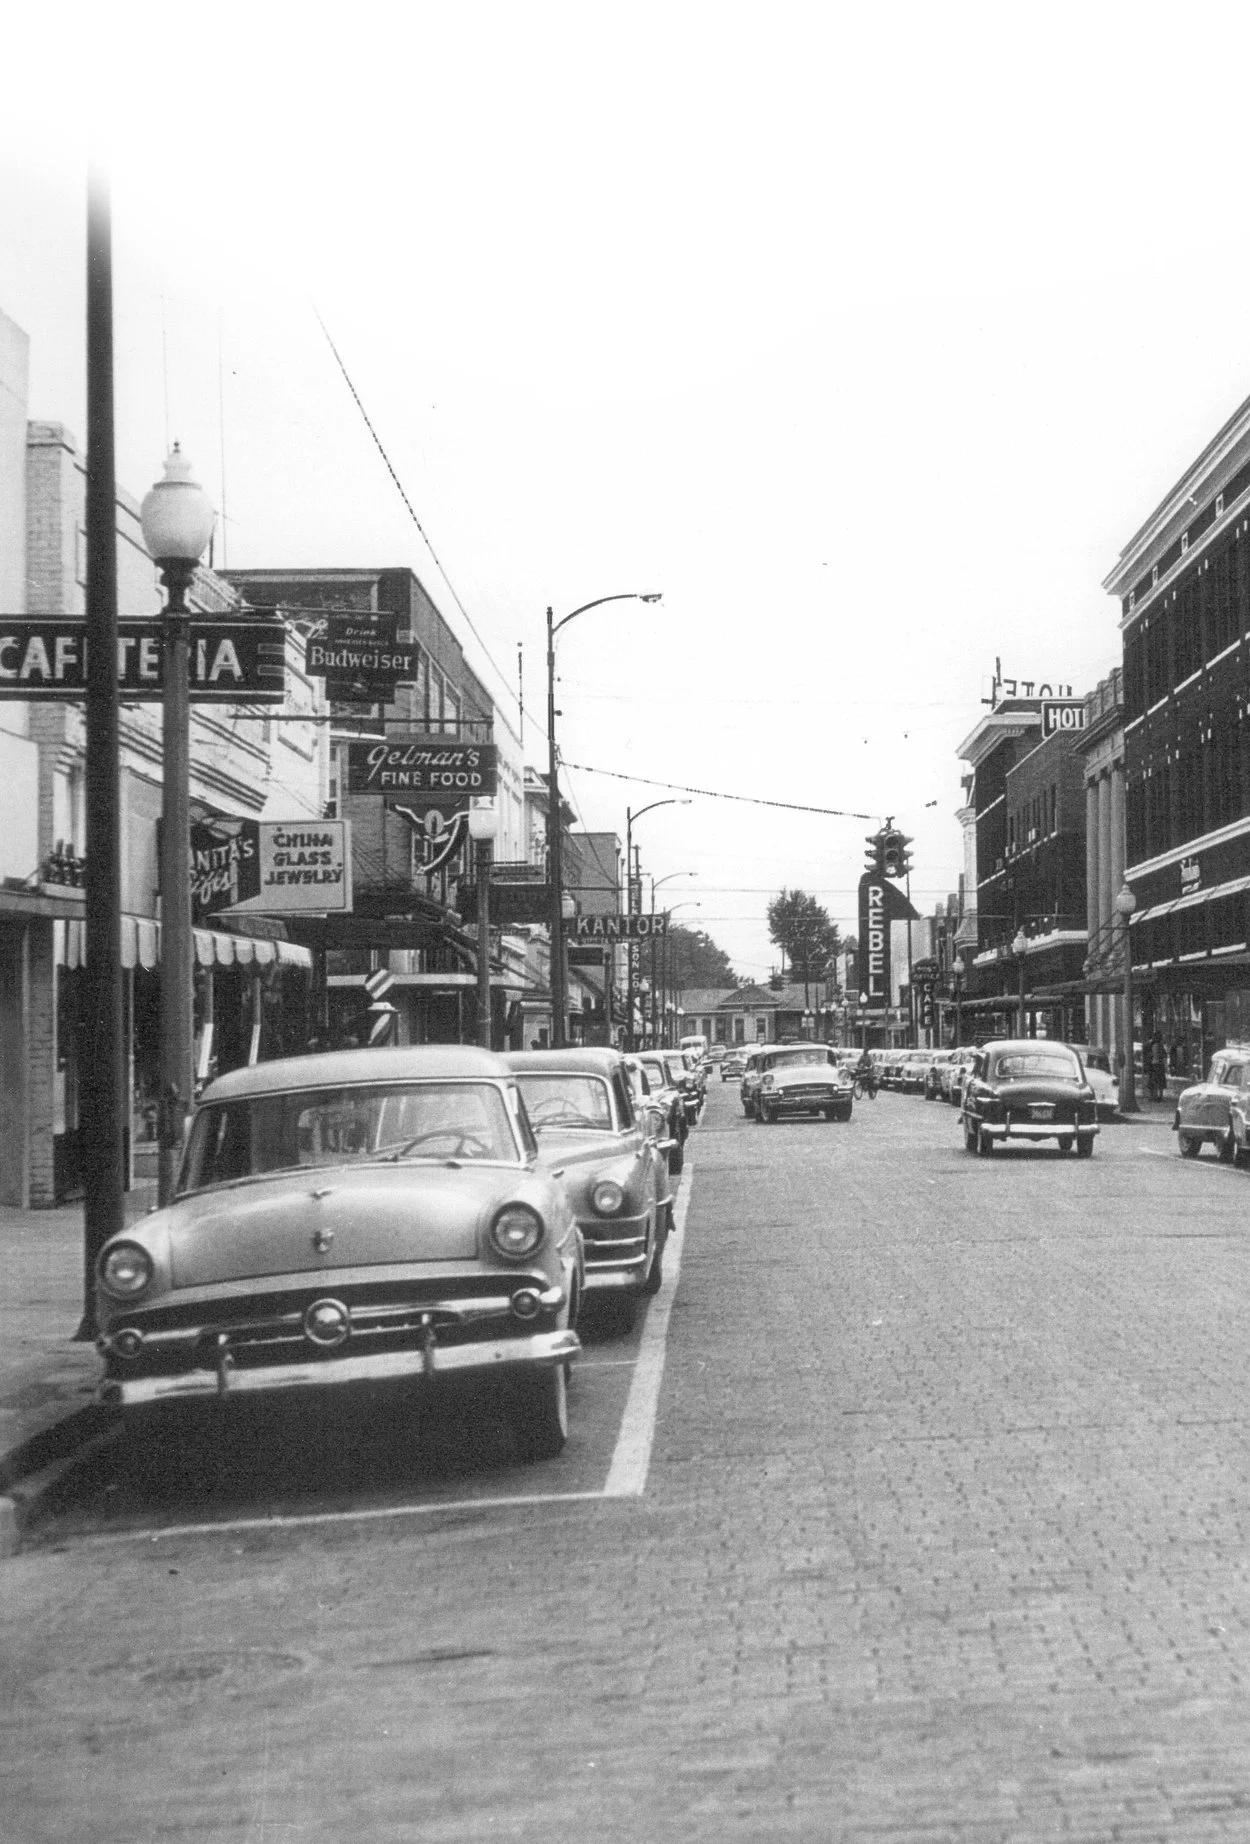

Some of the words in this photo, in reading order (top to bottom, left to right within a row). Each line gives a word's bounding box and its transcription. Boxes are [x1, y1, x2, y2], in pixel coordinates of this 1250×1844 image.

[0, 636, 245, 682] CAFTEIA
[310, 646, 412, 670] Budweiser
[1048, 708, 1085, 729] HOT
[381, 771, 422, 786] FINE
[430, 772, 482, 787] FOOD
[273, 851, 332, 867] GLASS
[264, 867, 342, 885] JEWELRY
[577, 915, 665, 935] KANTOR
[868, 886, 884, 996] REBEL
[924, 983, 932, 1024] CAFE
